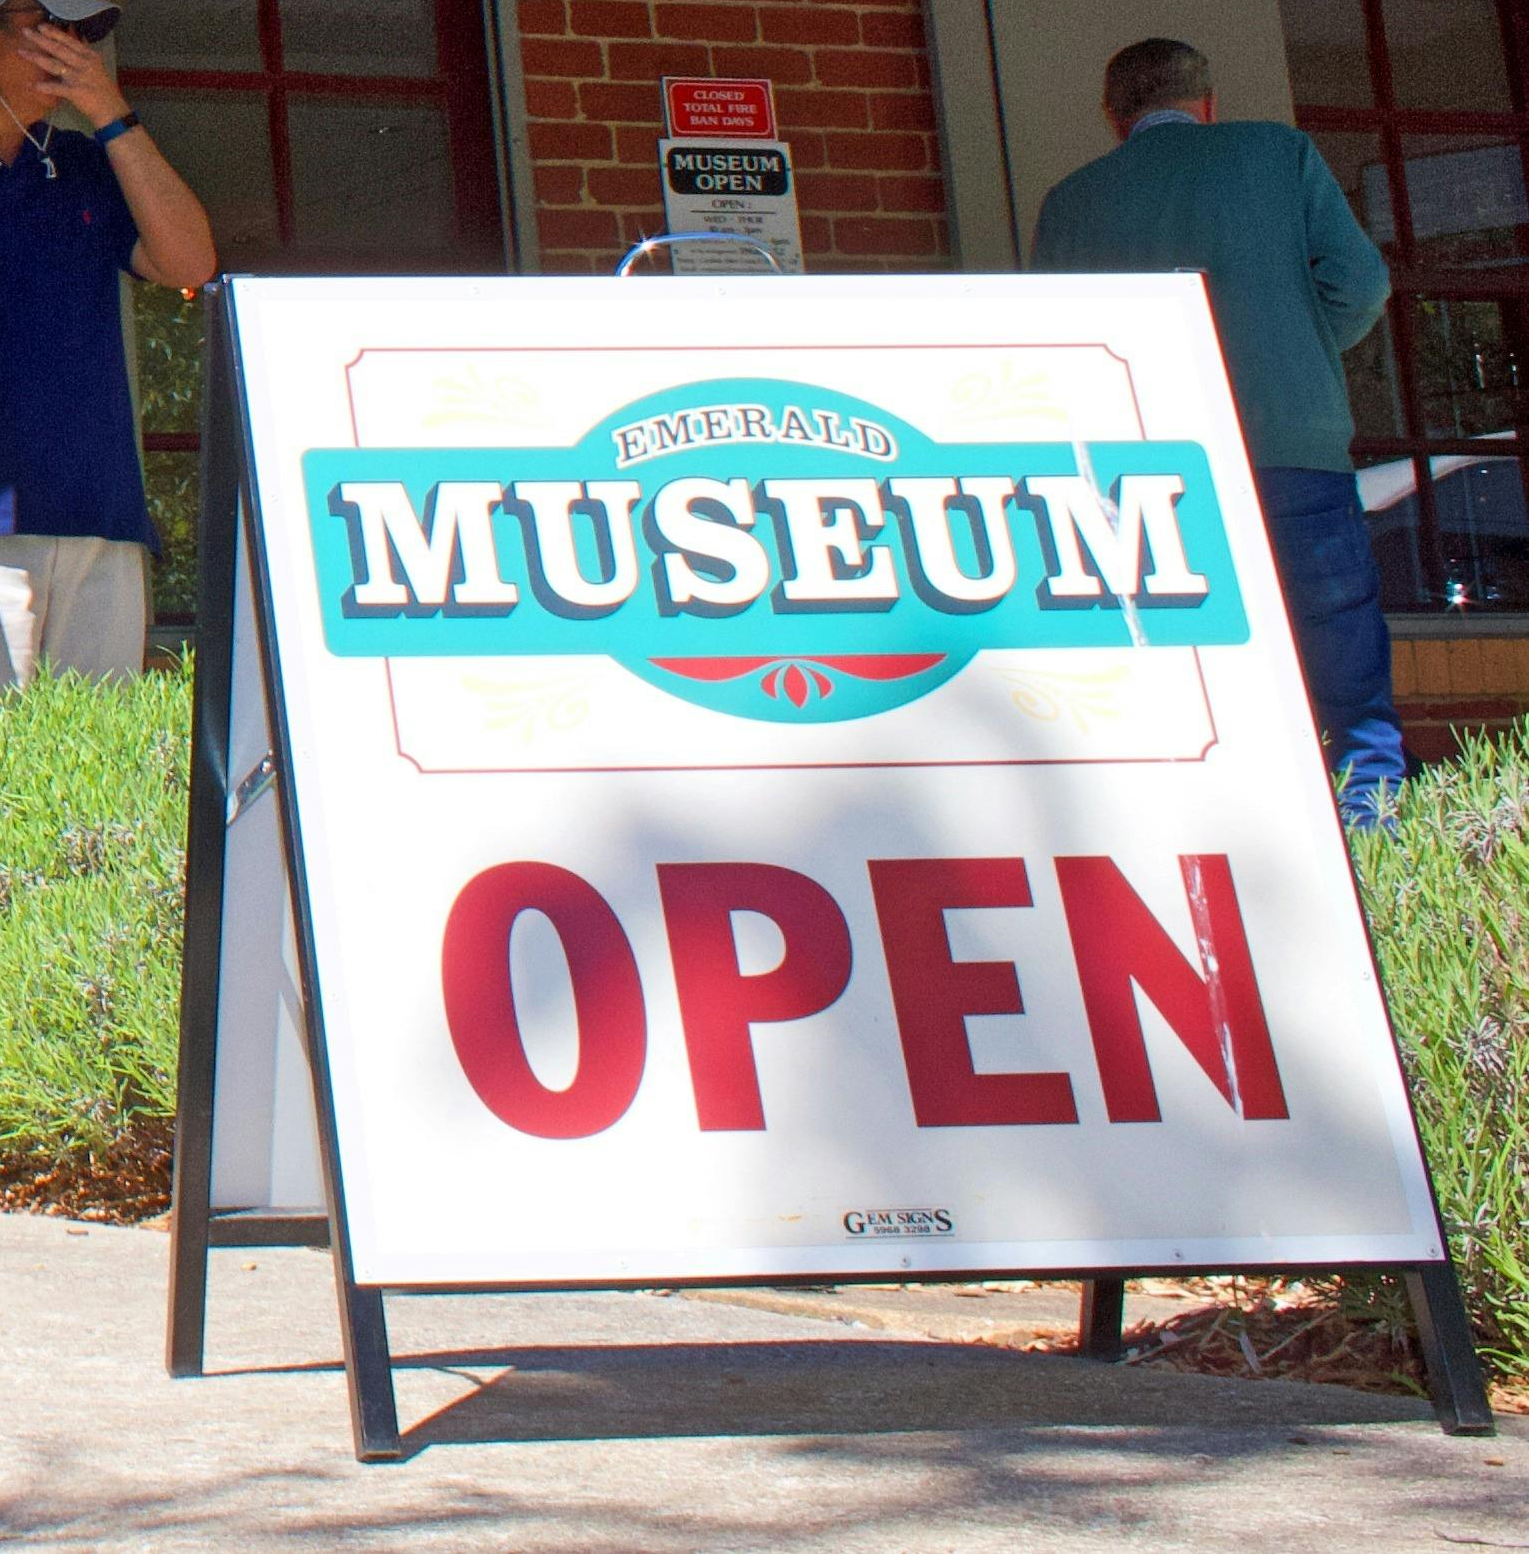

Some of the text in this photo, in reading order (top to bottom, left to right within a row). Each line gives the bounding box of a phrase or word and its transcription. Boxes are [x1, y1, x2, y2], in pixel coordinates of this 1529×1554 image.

[693, 90, 744, 102] CLOSED
[683, 102, 758, 115] TOTAL FIRE
[690, 115, 755, 127] BAN DAYS
[674, 153, 781, 173] MUSEUM
[695, 173, 763, 191] OPEN
[618, 405, 896, 467] EMERALD
[328, 475, 1207, 620] MUSEUM
[441, 853, 1291, 1140] OPEN
[844, 1209, 953, 1234] GEM SIGNS
